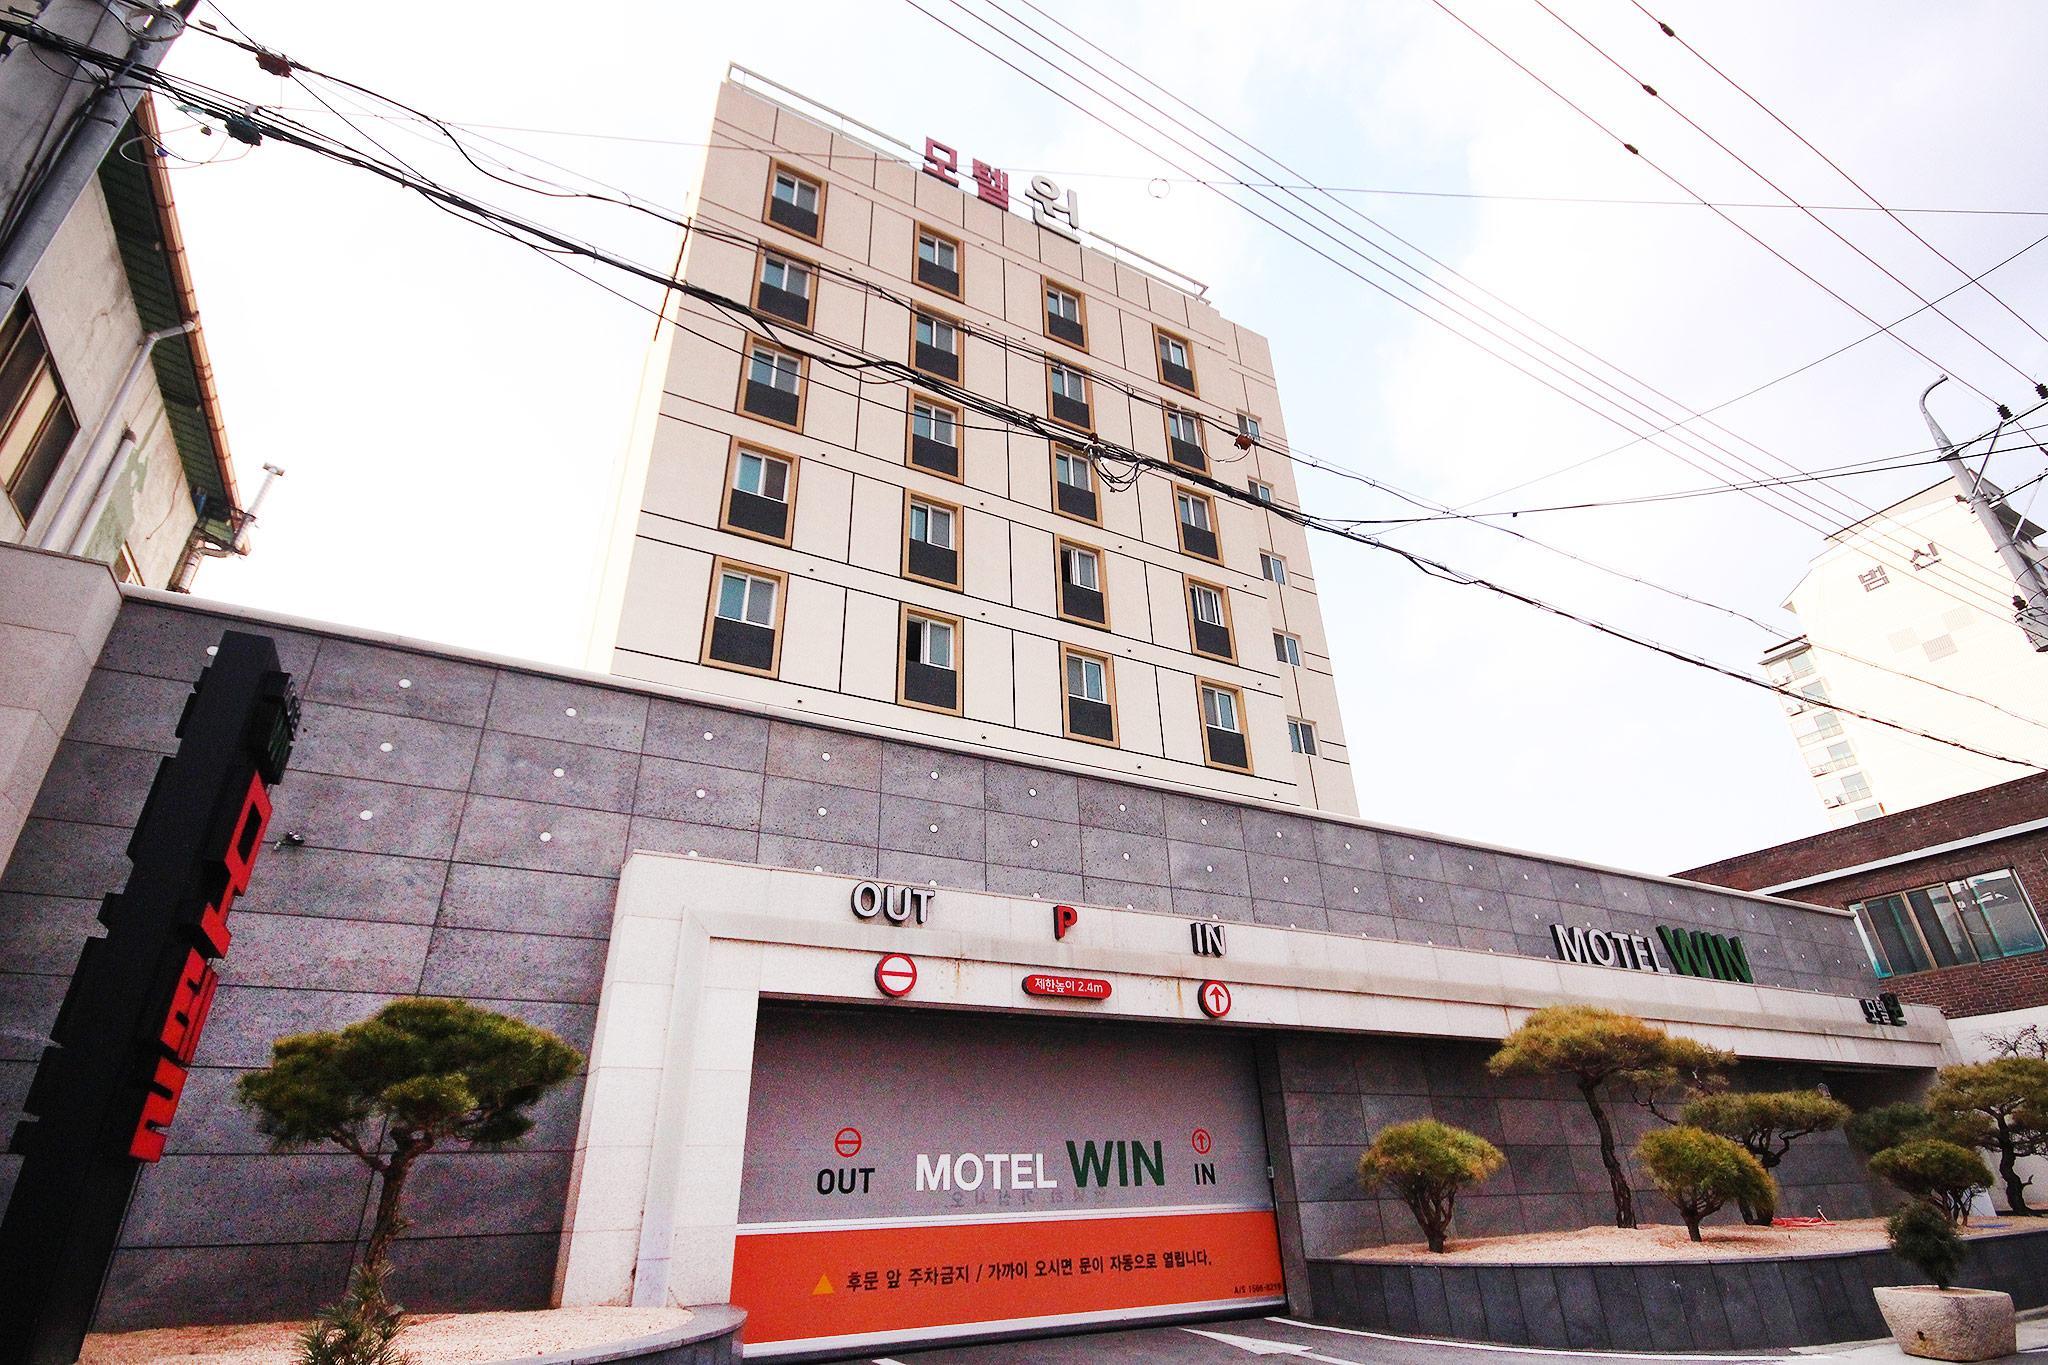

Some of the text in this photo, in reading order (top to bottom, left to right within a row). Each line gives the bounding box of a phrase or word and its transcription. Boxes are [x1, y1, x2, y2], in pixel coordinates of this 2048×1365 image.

[851, 880, 935, 924] OUT
[1053, 904, 1078, 941] P
[1190, 922, 1227, 957] IN
[1550, 923, 1754, 984] MOTEL WIN
[1034, 977, 1104, 993] 제한높이 2.4m
[816, 1167, 876, 1196] OUT
[915, 1139, 1165, 1193] MOTEL WIN
[1194, 1163, 1216, 1186] IN
[846, 1270, 879, 1292] 후문
[886, 1269, 901, 1289] 앞
[907, 1263, 969, 1287] 주차금지
[988, 1261, 1028, 1281] 가까이
[1034, 1258, 1073, 1277] 오시면
[1079, 1255, 1104, 1275] 문이
[1110, 1253, 1158, 1272] 자동으로
[1162, 1249, 1212, 1269] 열립니다.
